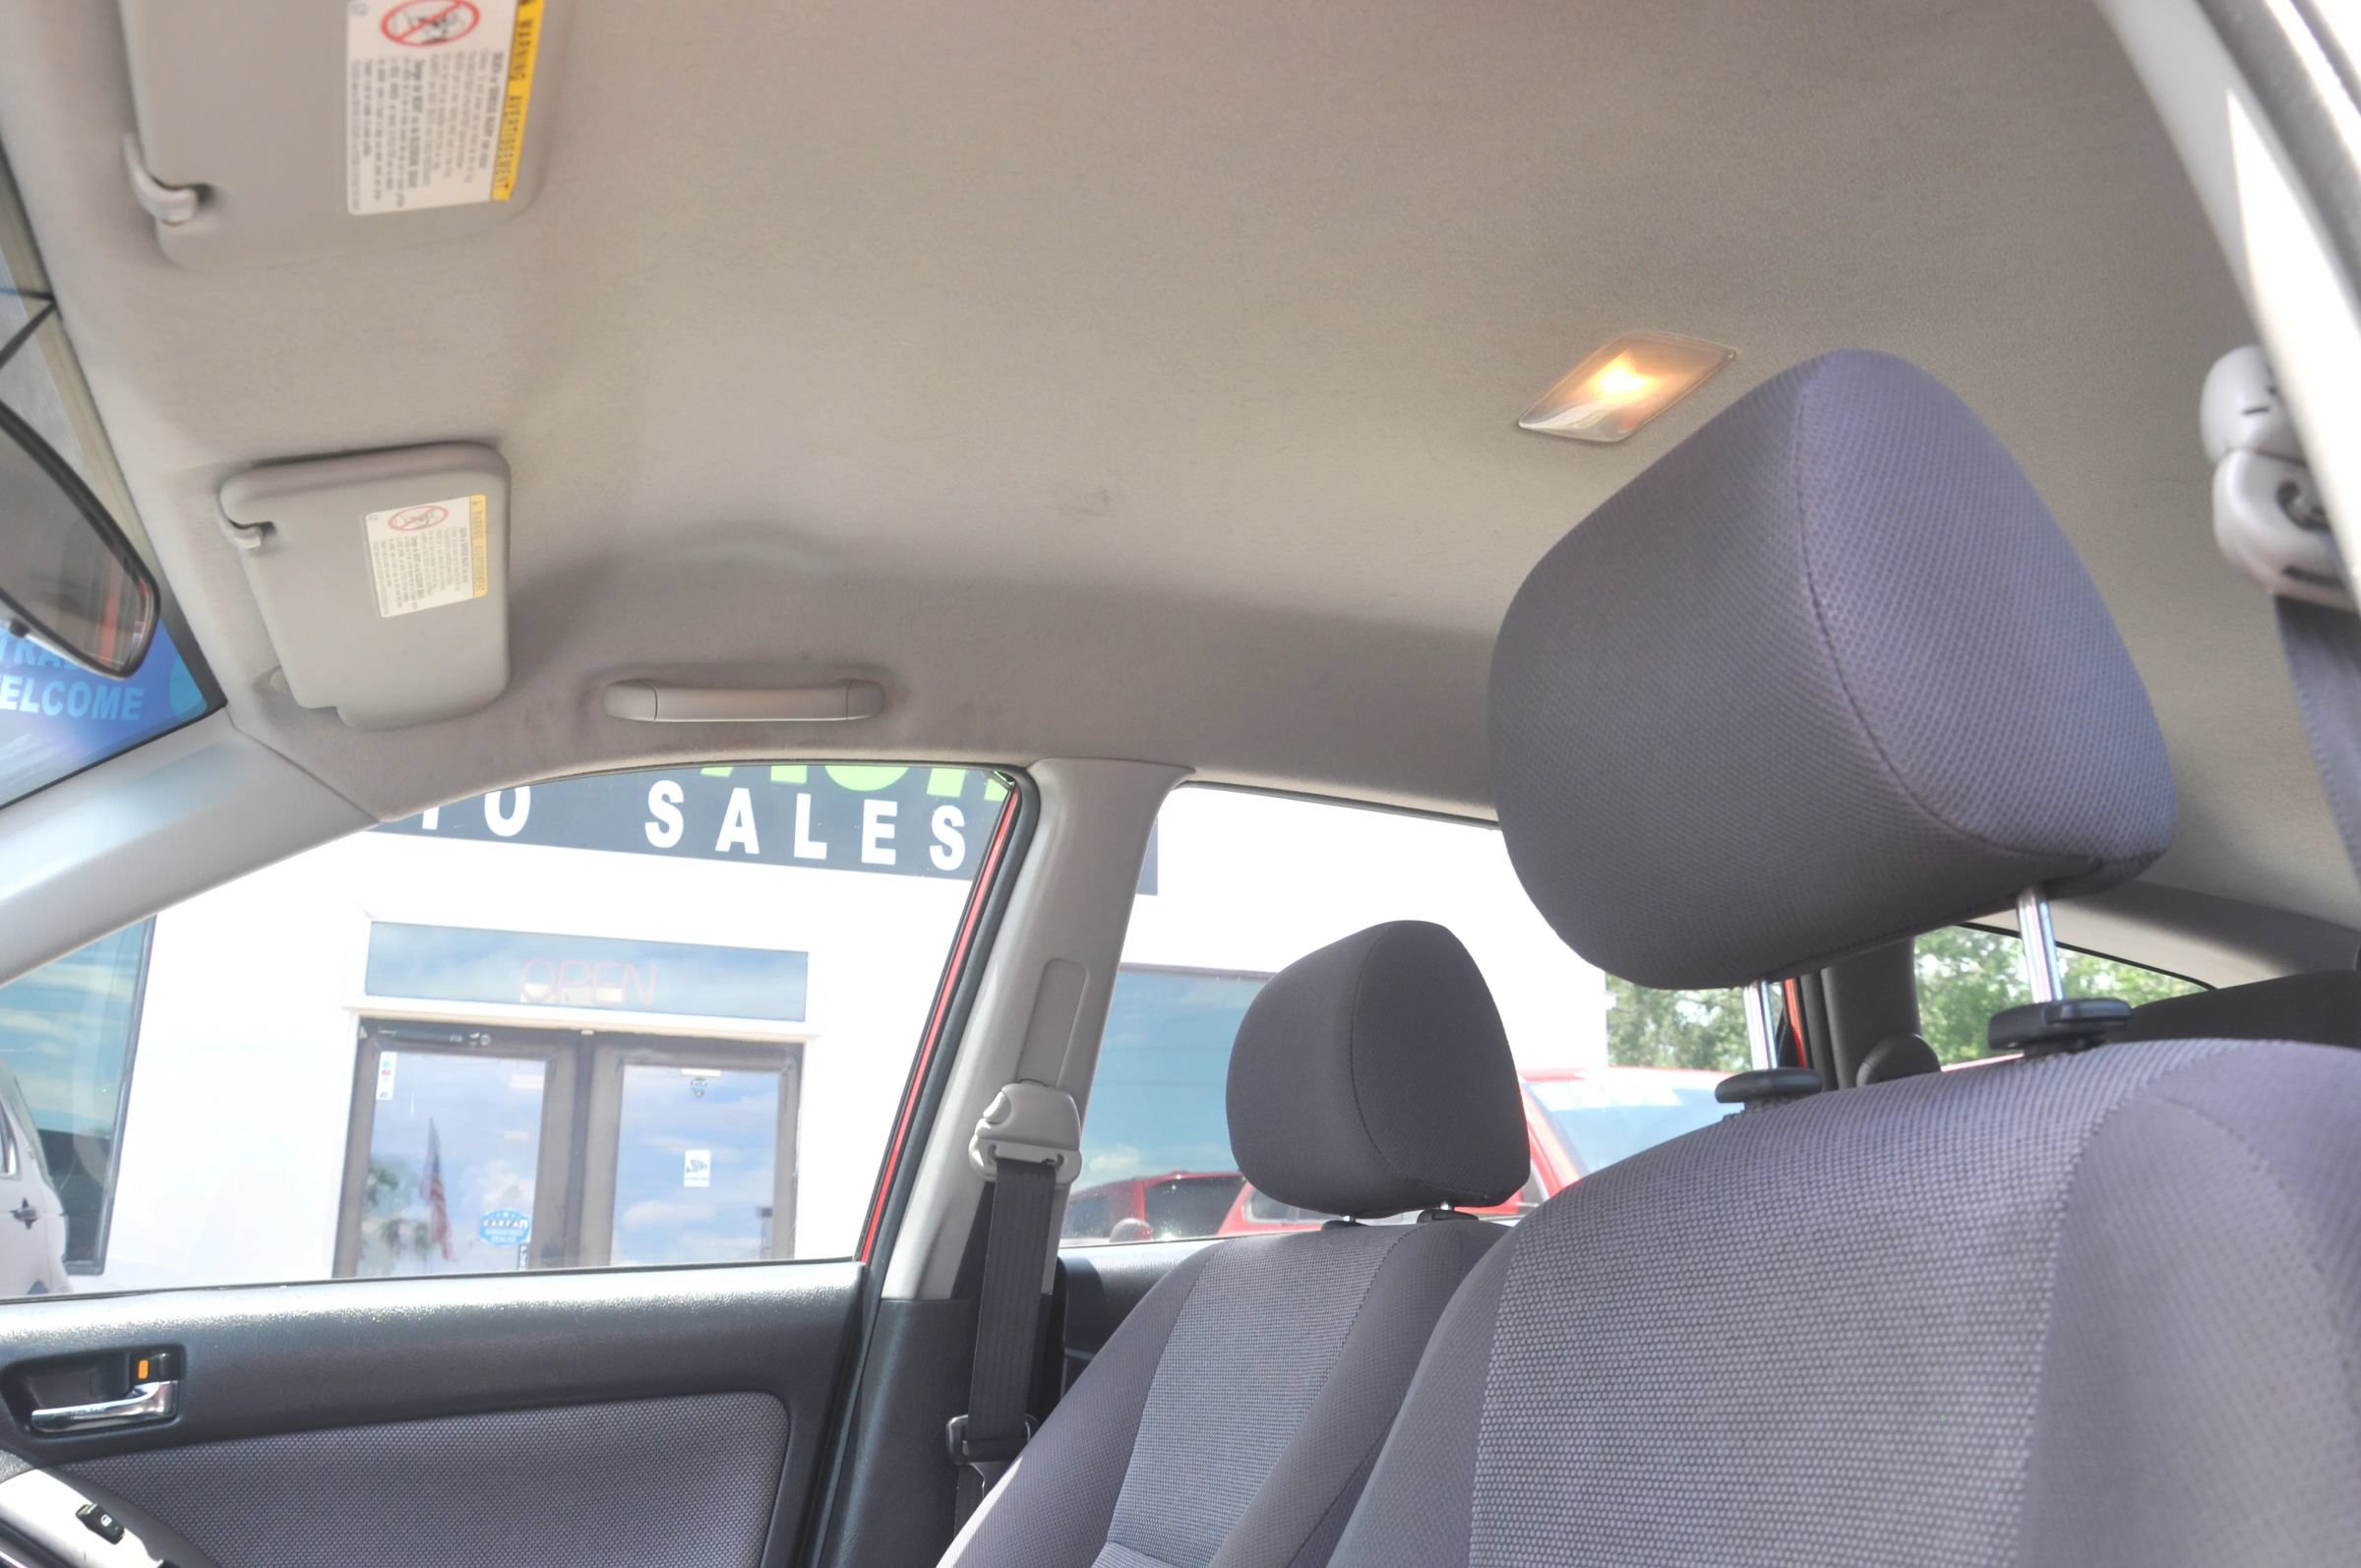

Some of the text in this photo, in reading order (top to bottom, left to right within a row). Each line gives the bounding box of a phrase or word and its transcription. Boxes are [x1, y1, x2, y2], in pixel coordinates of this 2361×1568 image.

[0, 675, 145, 721] ELCOME
[644, 779, 966, 872] SALES
[519, 957, 659, 1007] OPEN
